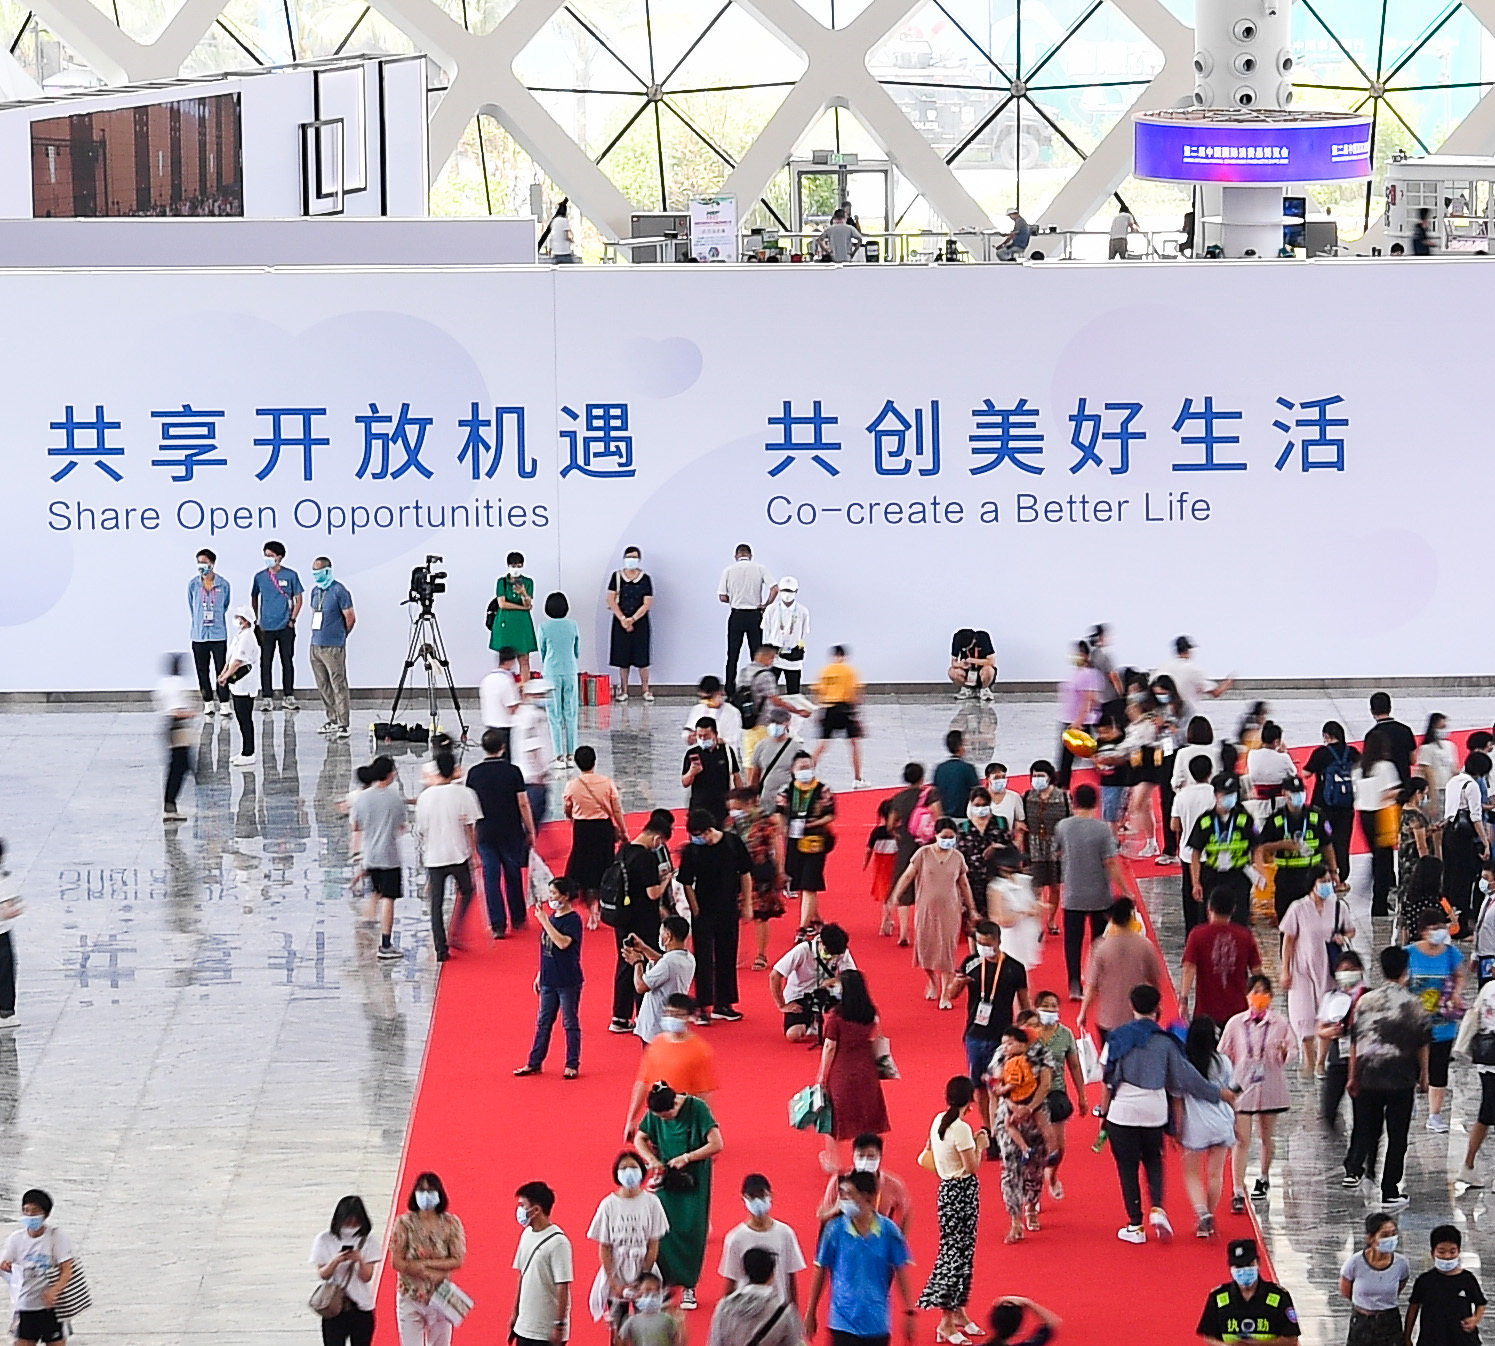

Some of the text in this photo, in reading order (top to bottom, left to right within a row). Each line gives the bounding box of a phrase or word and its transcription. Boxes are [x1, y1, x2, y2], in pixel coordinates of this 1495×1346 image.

[47, 394, 1348, 483] 共享开放机遇 共创美好生活
[48, 498, 550, 537] Share Open Opportunities
[766, 492, 1211, 526] Co-create a Better Life
